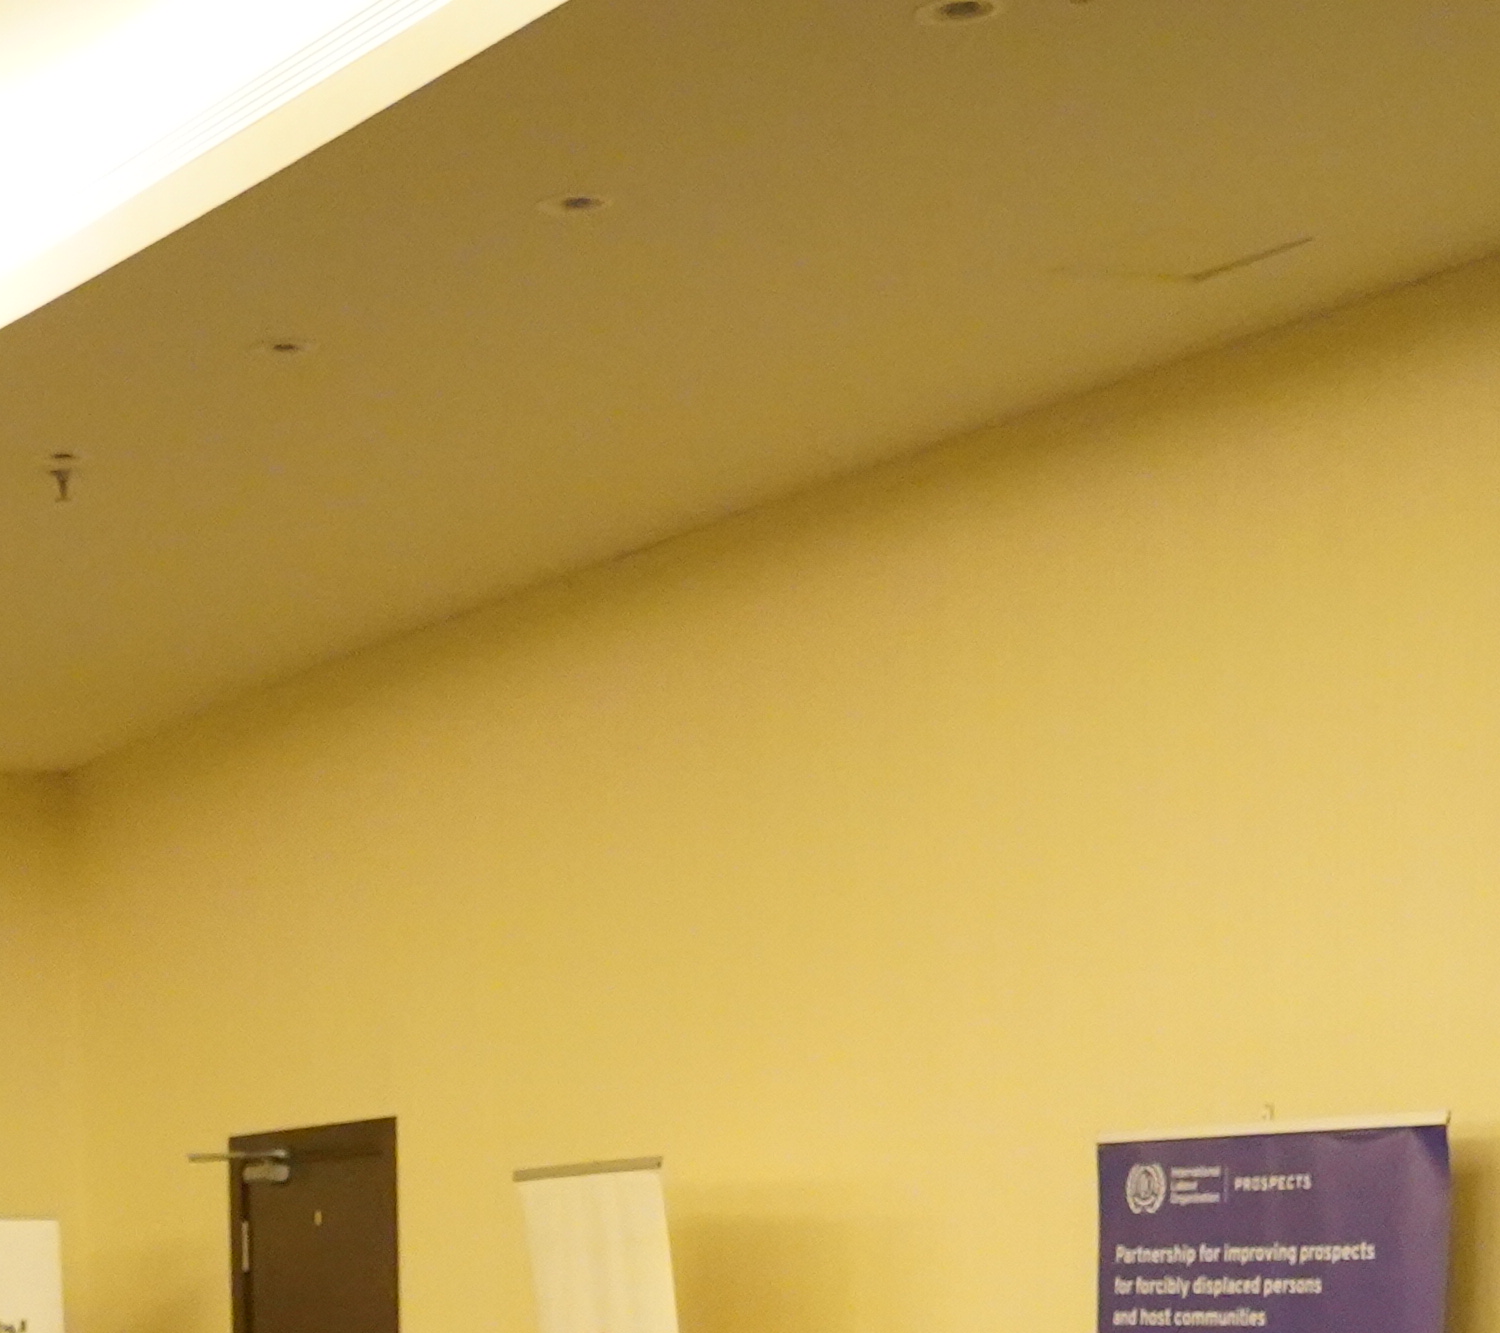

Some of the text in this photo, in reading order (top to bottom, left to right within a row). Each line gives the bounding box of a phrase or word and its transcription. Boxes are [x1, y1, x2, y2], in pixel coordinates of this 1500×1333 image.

[1233, 1172, 1313, 1192] PROSPECTS
[1115, 1241, 1377, 1267] Partnership for improving prospects
[1114, 1274, 1323, 1299] for forcibly displaced persons
[1112, 1306, 1268, 1328] and host communities
